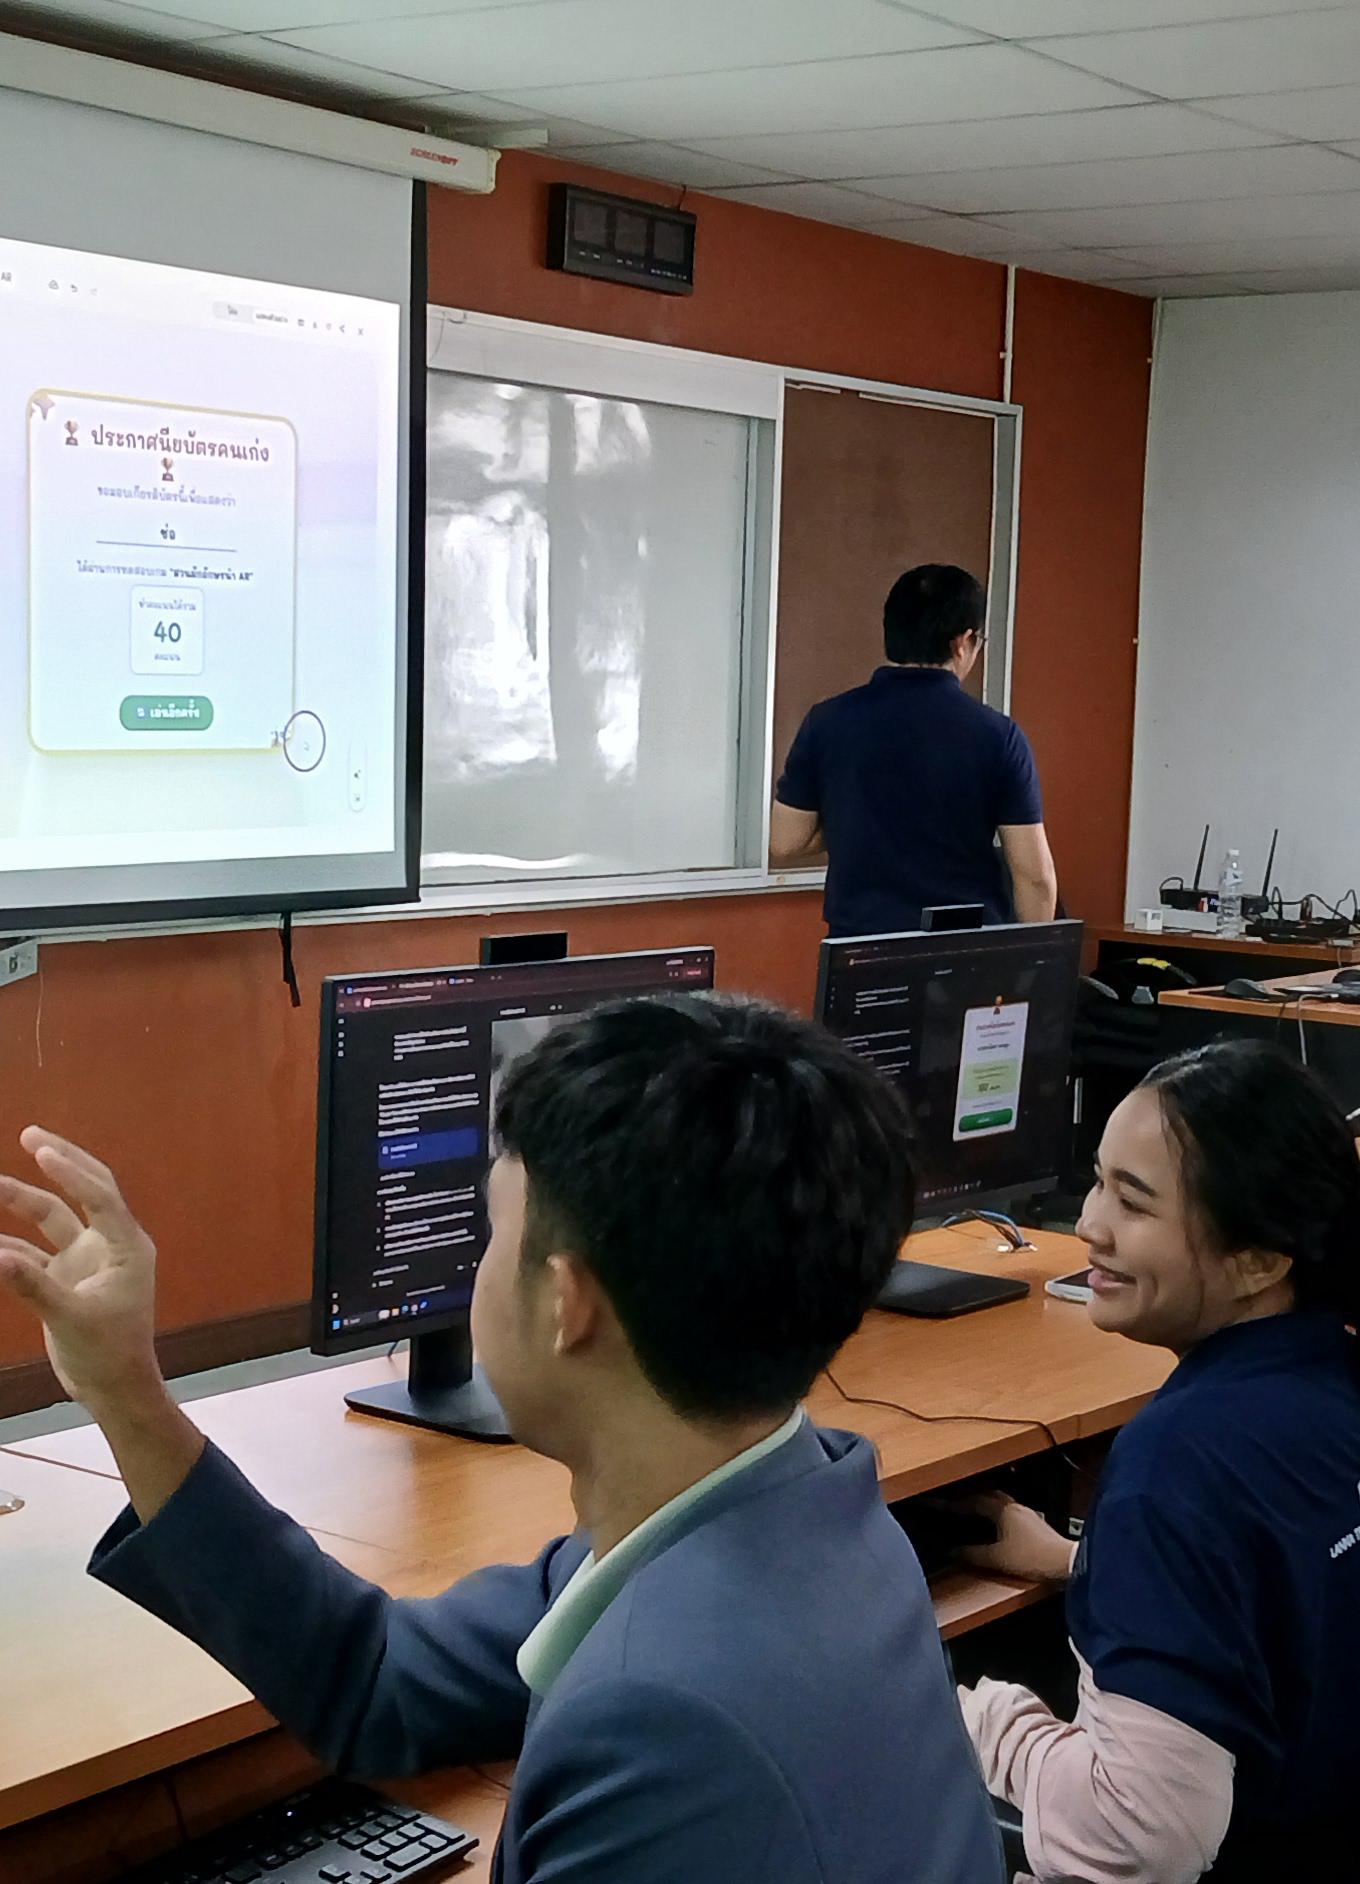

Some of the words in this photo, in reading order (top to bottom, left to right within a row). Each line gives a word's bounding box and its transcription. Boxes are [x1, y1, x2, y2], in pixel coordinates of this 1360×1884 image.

[91, 426, 270, 463] ประกาศนียบัตรคนเก่ง
[154, 620, 182, 643] 40
